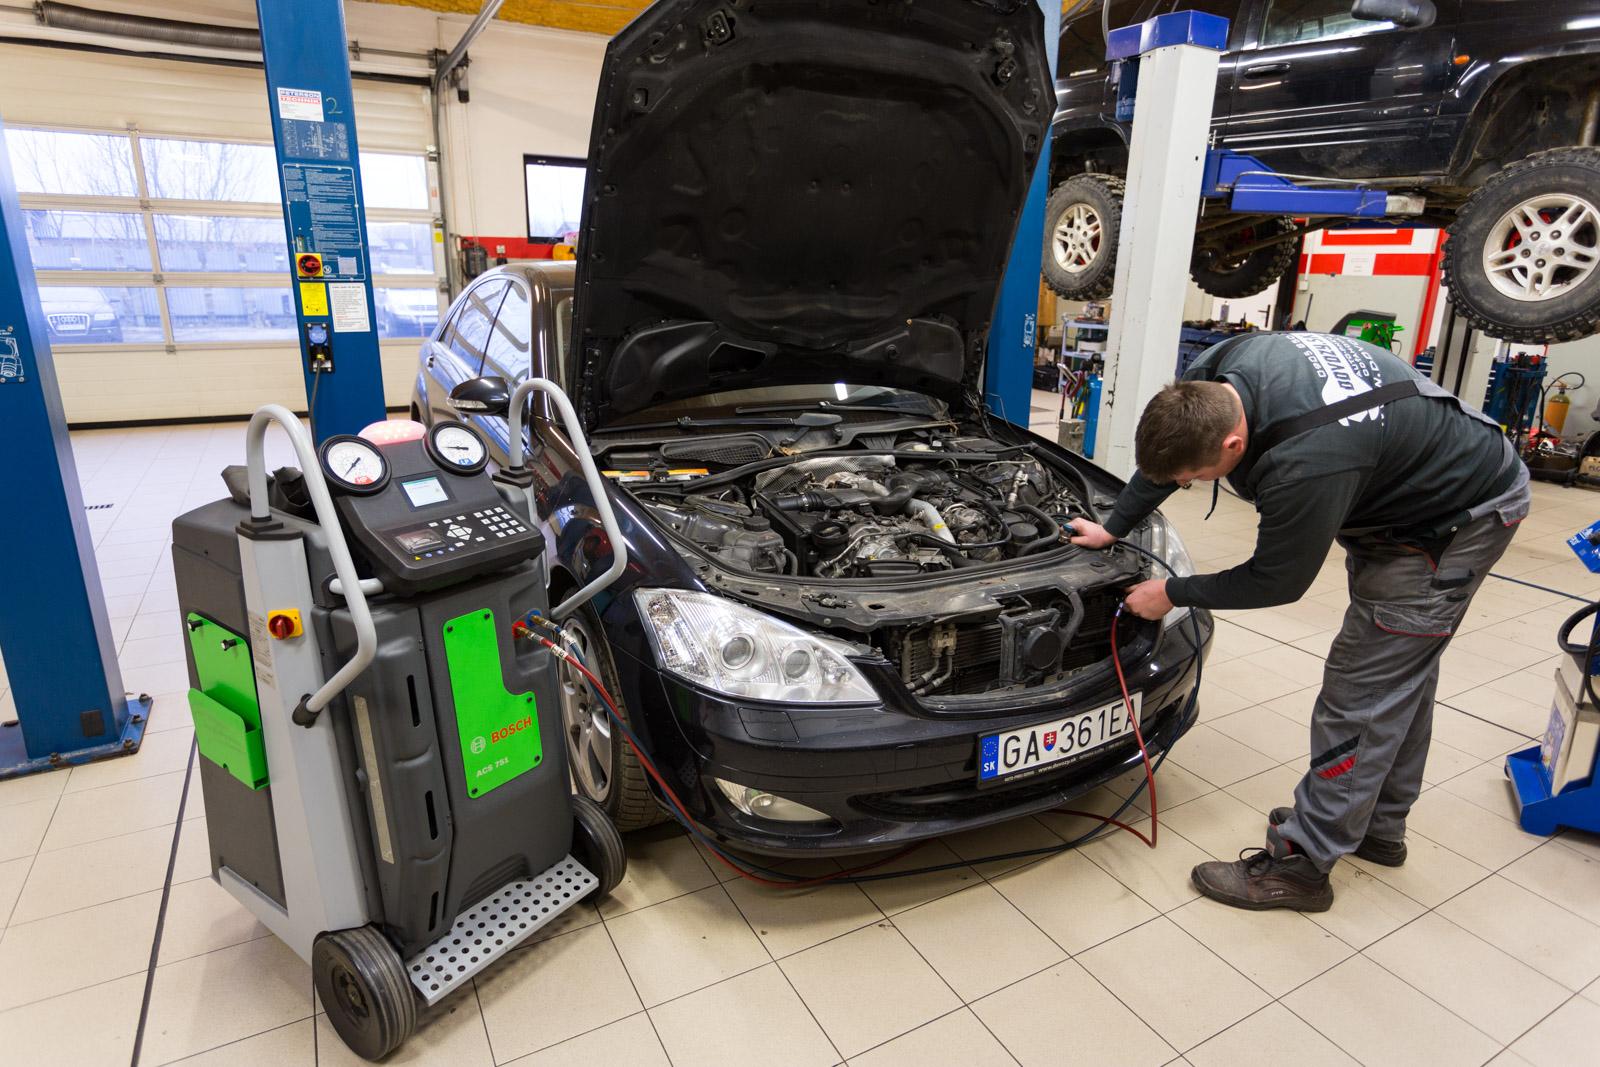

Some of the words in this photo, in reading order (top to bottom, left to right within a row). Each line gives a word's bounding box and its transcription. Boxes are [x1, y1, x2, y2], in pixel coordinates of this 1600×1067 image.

[326, 97, 343, 115] 2
[1304, 350, 1327, 378] 0905
[491, 716, 533, 744] BOSCH
[1003, 730, 1040, 768] GA
[1059, 698, 1136, 753] 361EA
[476, 763, 494, 779] ACS
[495, 757, 510, 771] 751
[983, 762, 996, 775] SK
